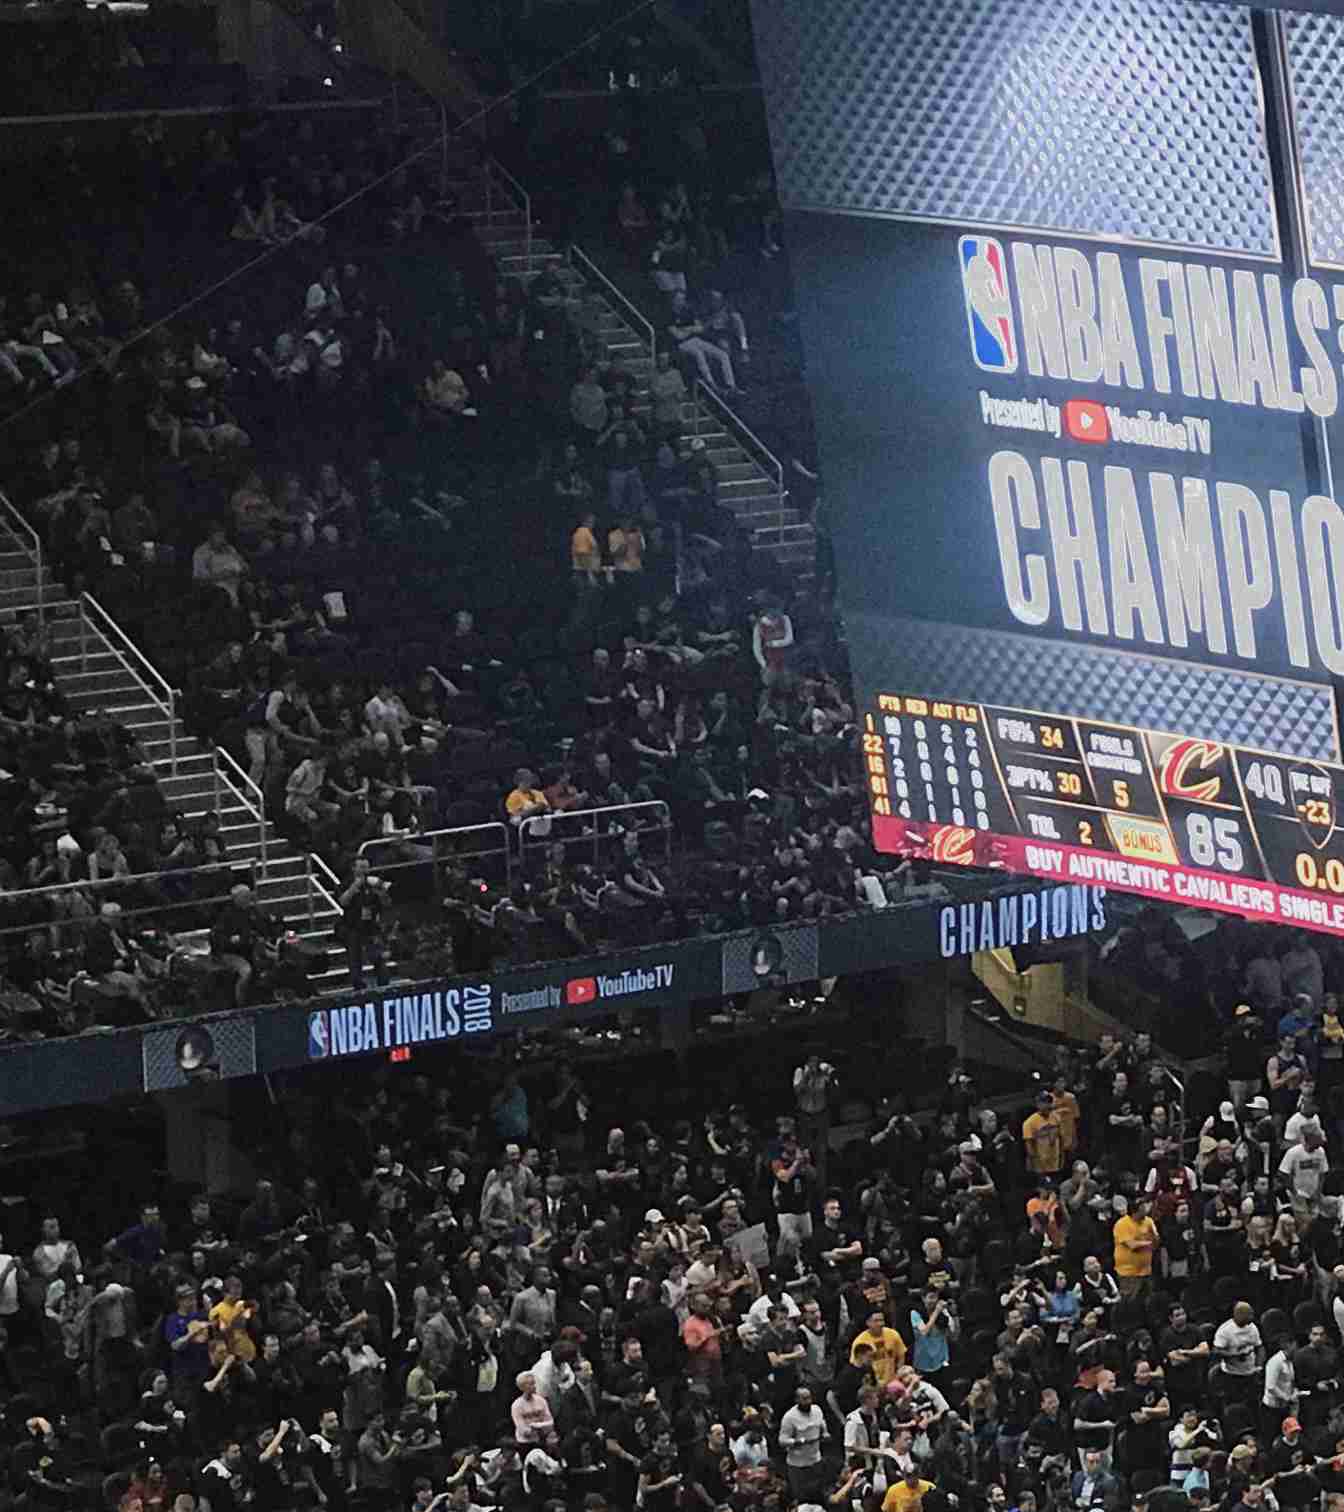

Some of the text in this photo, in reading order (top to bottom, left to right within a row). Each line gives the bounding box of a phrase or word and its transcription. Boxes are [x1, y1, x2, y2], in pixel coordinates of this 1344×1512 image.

[1011, 240, 1338, 418] NBA FINALS
[979, 391, 1043, 432] Presented
[863, 734, 884, 753] 22
[941, 724, 952, 744] 2
[965, 728, 977, 747] 2
[1040, 725, 1063, 749] 34
[893, 758, 905, 777] 2
[1056, 771, 1081, 795] 30
[1112, 780, 1129, 808] 5
[1078, 821, 1093, 844] 2
[1186, 812, 1243, 872] 85
[1025, 845, 1063, 874] BUY
[1069, 849, 1170, 892] AUTHENTIC
[1174, 871, 1275, 913] CAVALIERS
[940, 886, 1107, 959] CHAMPIONS
[329, 988, 461, 1057] NBA FINALS
[463, 984, 492, 1033] 2018
